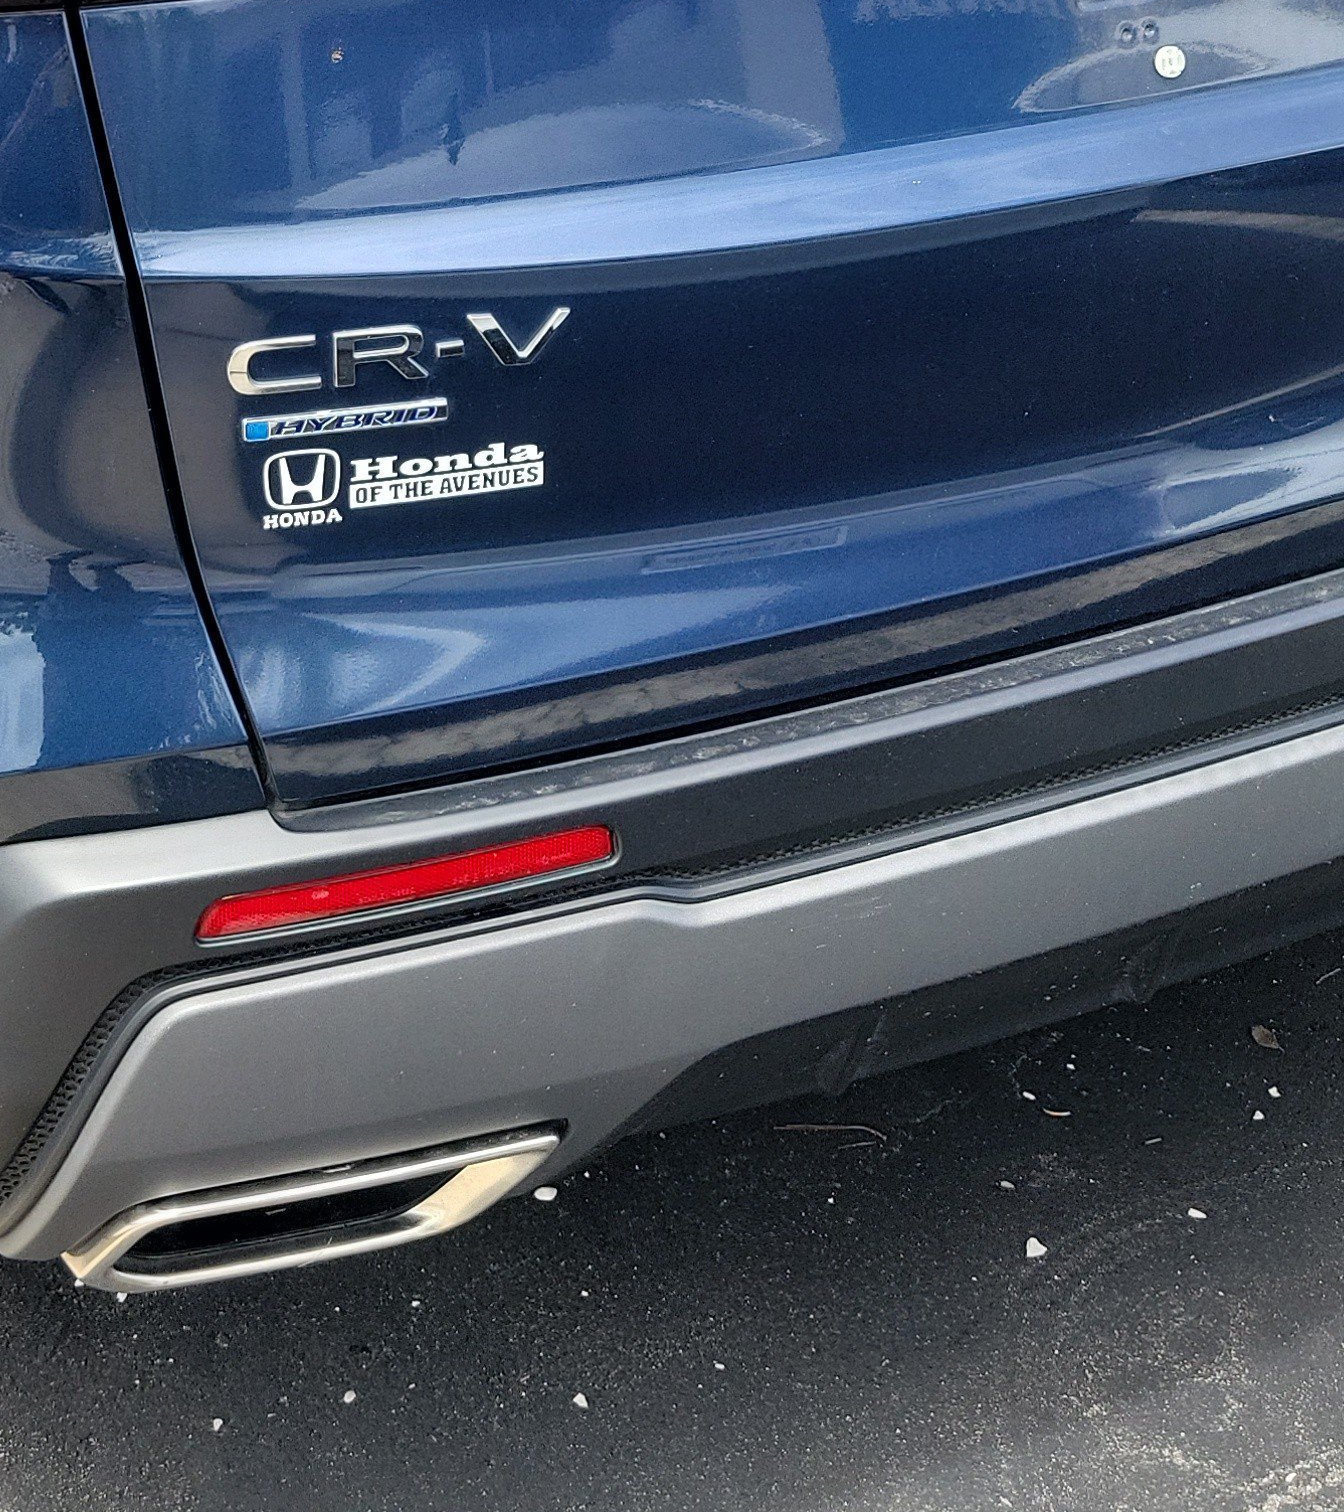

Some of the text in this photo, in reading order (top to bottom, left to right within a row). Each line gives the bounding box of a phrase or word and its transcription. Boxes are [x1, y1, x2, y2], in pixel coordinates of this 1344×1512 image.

[226, 306, 571, 396] CR-V
[273, 404, 439, 436] HYBRID
[350, 441, 544, 482] Honda
[356, 465, 539, 504] OF THE AVENUES
[263, 508, 343, 529] HONDA
